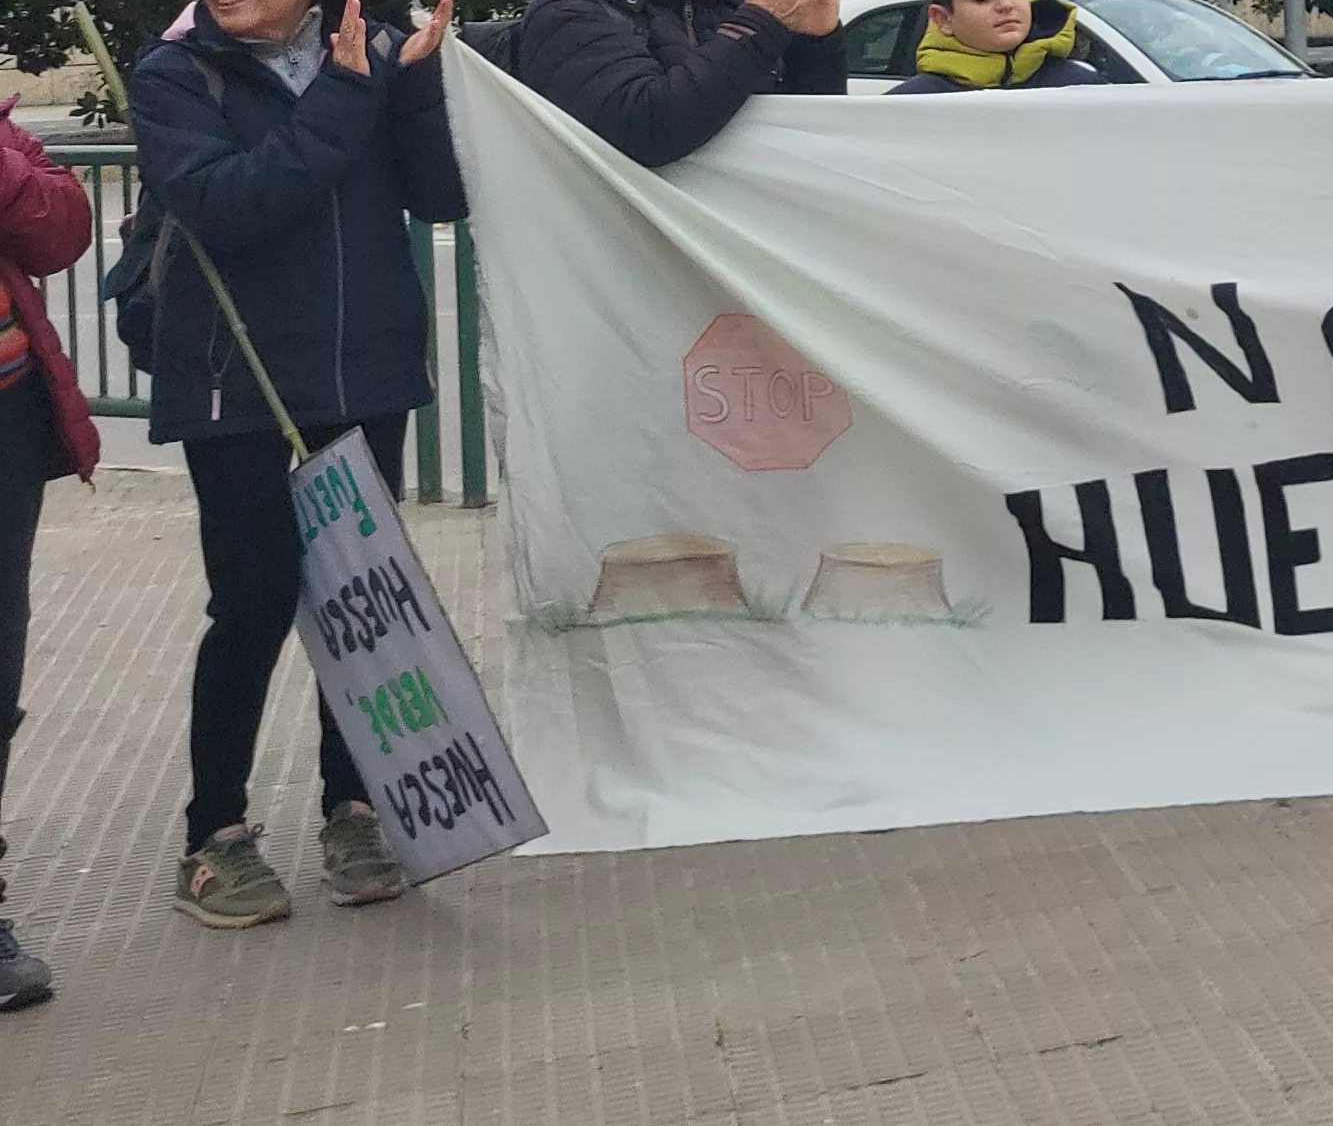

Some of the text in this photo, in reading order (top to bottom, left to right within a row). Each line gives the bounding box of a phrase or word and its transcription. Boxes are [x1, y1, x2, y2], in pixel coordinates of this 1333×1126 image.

[691, 364, 836, 425] STOP
[301, 454, 377, 546] FUERT
[316, 556, 432, 662] HUESCA
[384, 731, 517, 841] HUESCA
